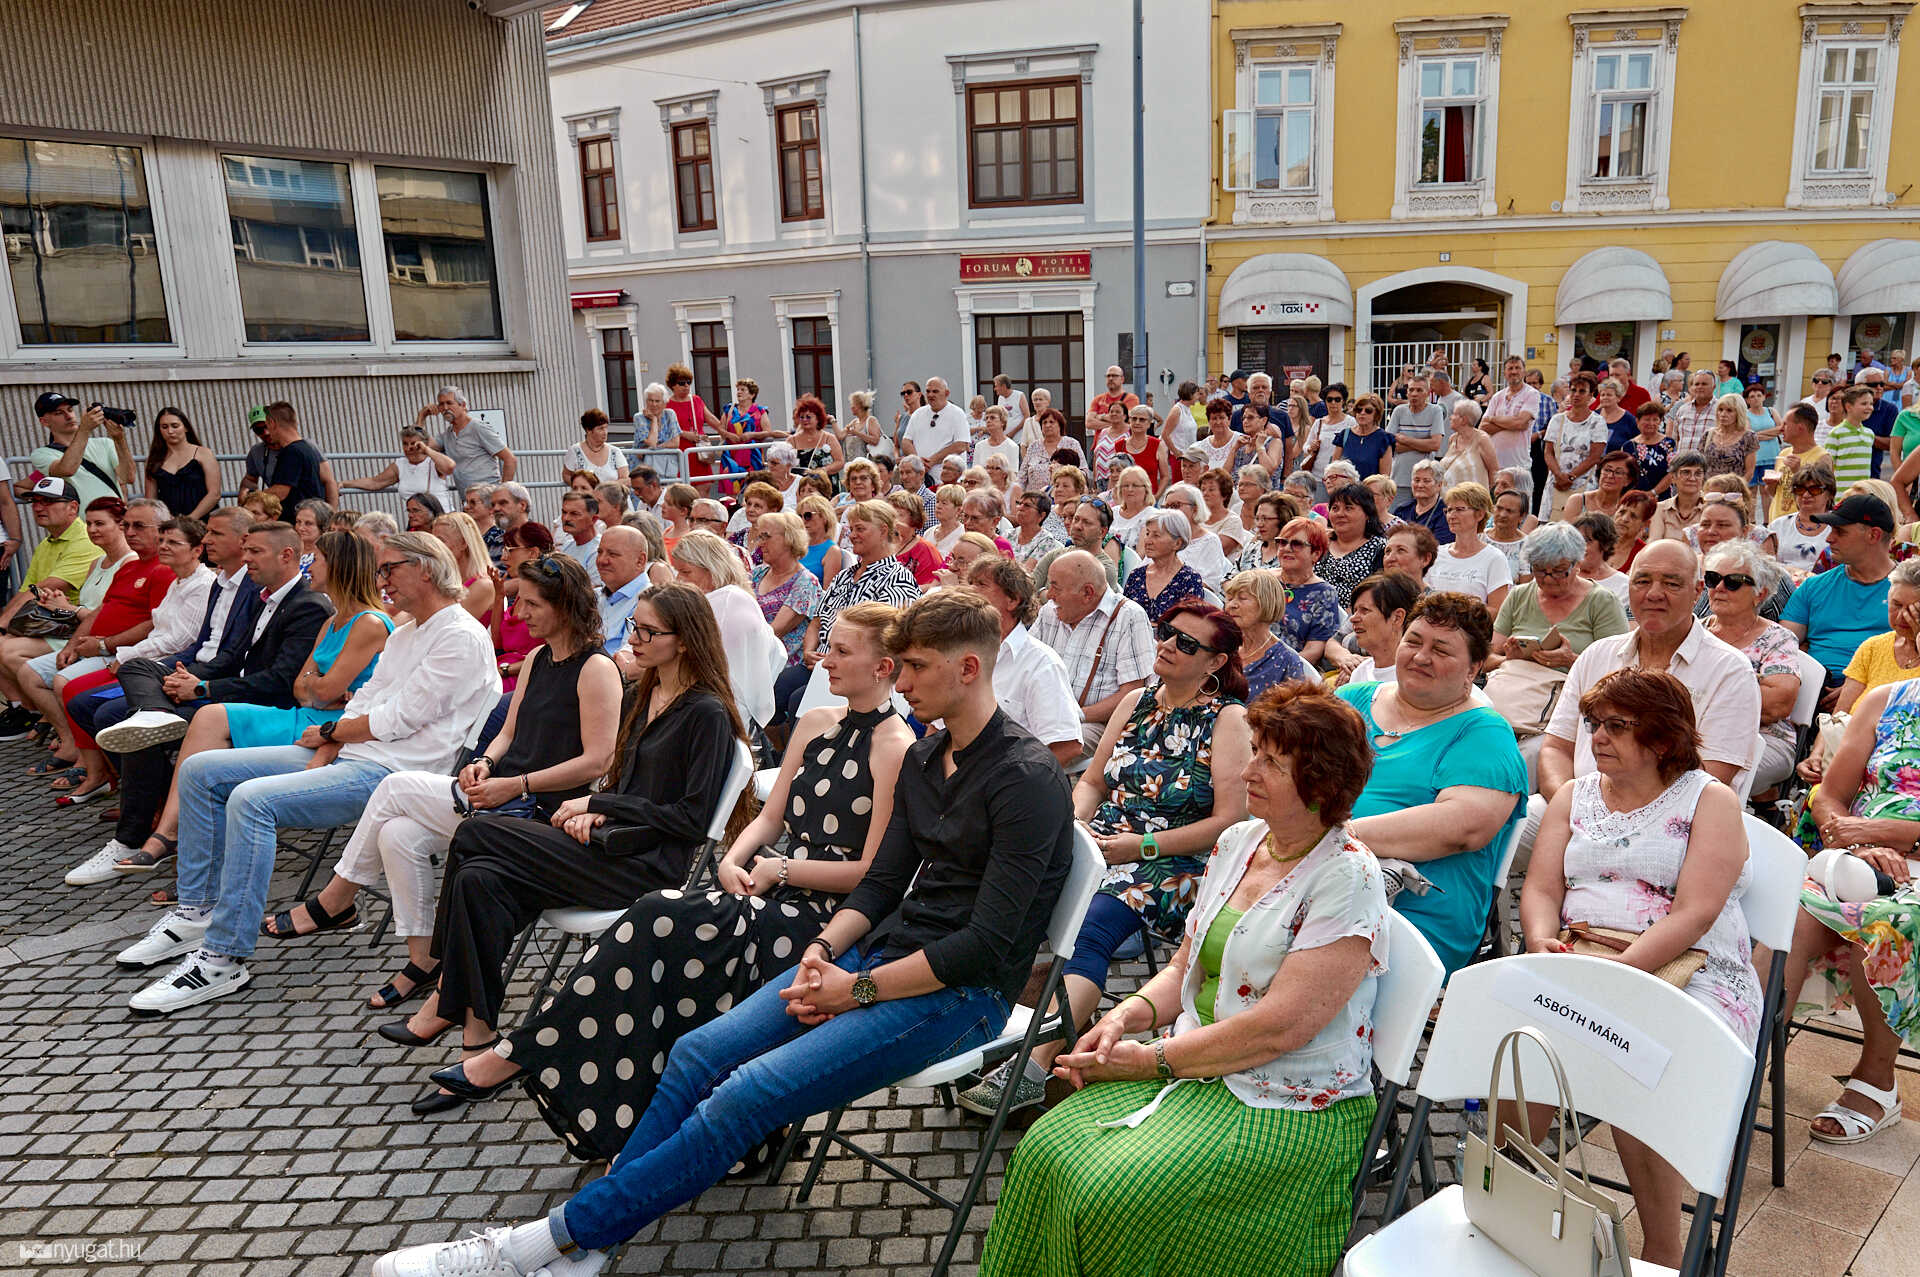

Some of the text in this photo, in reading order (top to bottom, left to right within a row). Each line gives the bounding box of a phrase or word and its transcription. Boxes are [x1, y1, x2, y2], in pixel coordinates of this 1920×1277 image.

[1041, 257, 1082, 265] HOTEL
[966, 264, 1010, 273] FORUM
[1280, 303, 1303, 313] Taxi
[1534, 994, 1631, 1053] ASBÓTH MÁRIA
